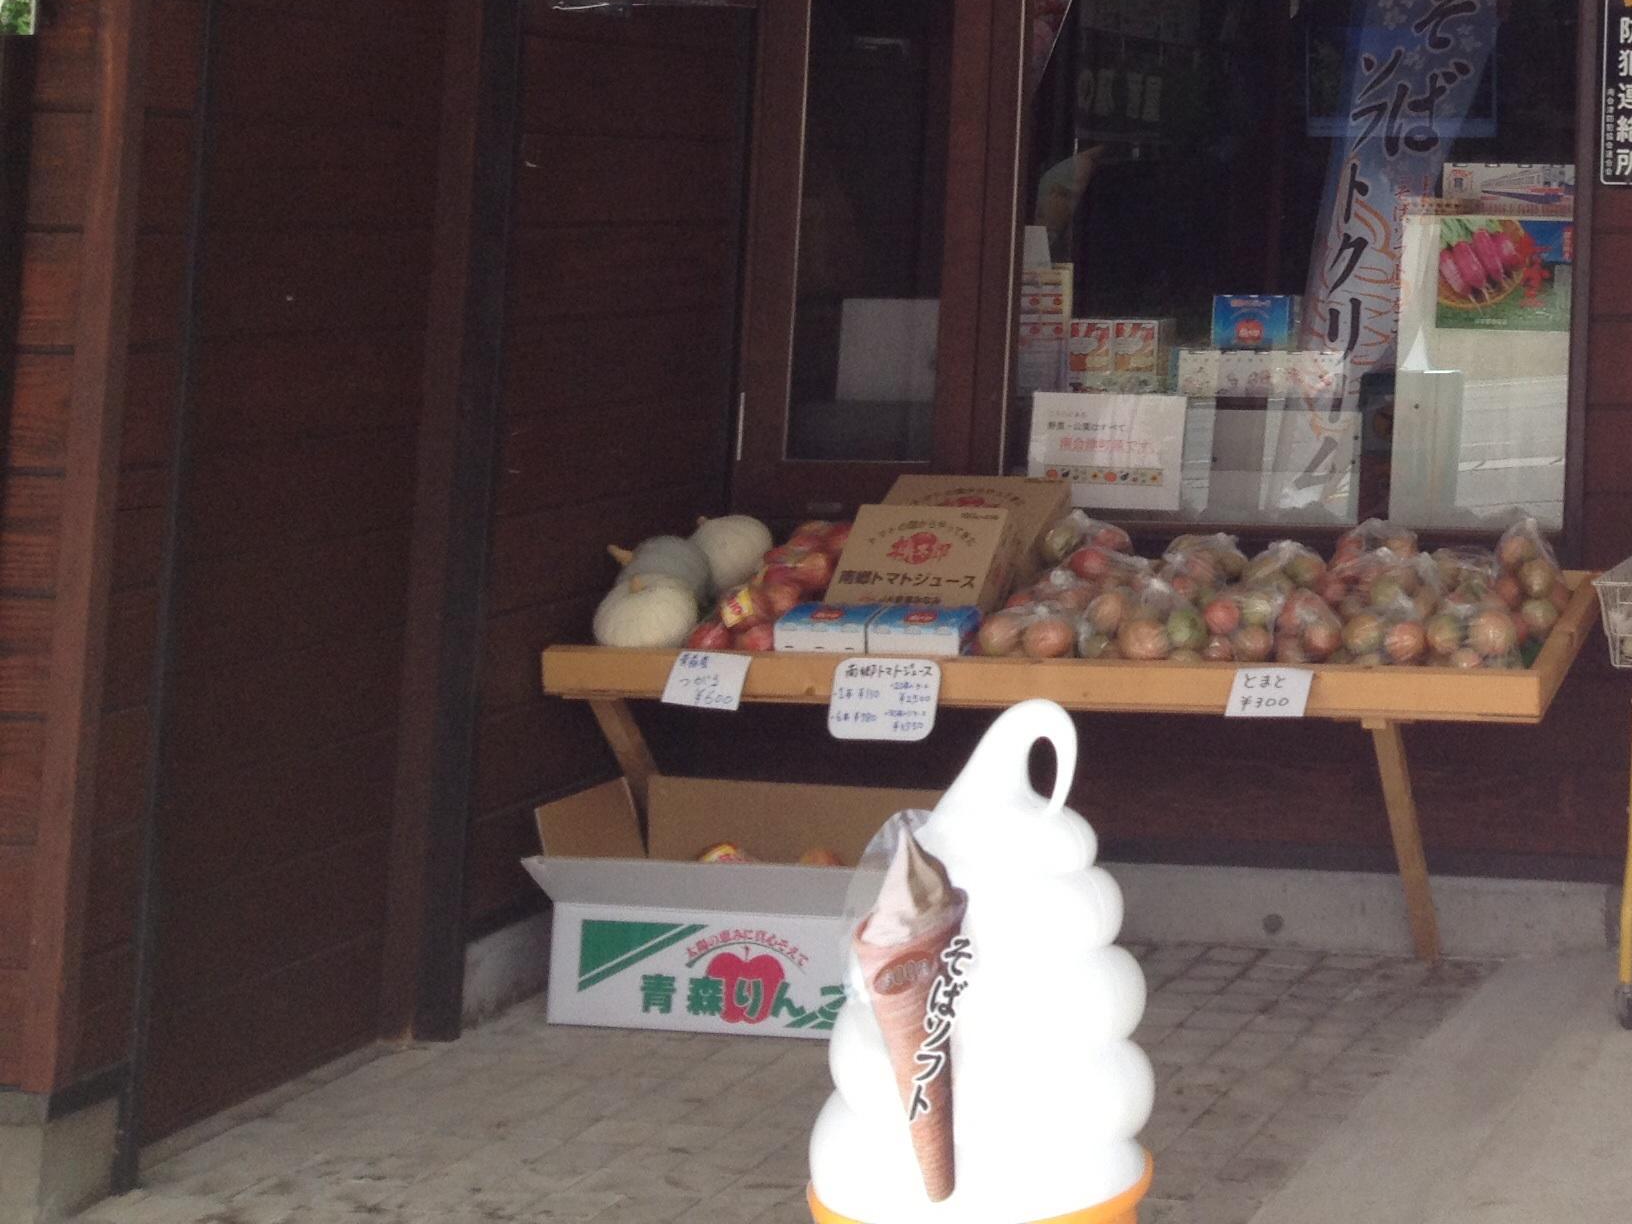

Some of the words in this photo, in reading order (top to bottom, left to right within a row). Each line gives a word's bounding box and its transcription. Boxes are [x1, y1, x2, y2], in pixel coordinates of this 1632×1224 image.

[838, 569, 977, 590] 南郷トマトジュース
[1243, 673, 1286, 689] とまと
[908, 937, 974, 1122] そばソフト
